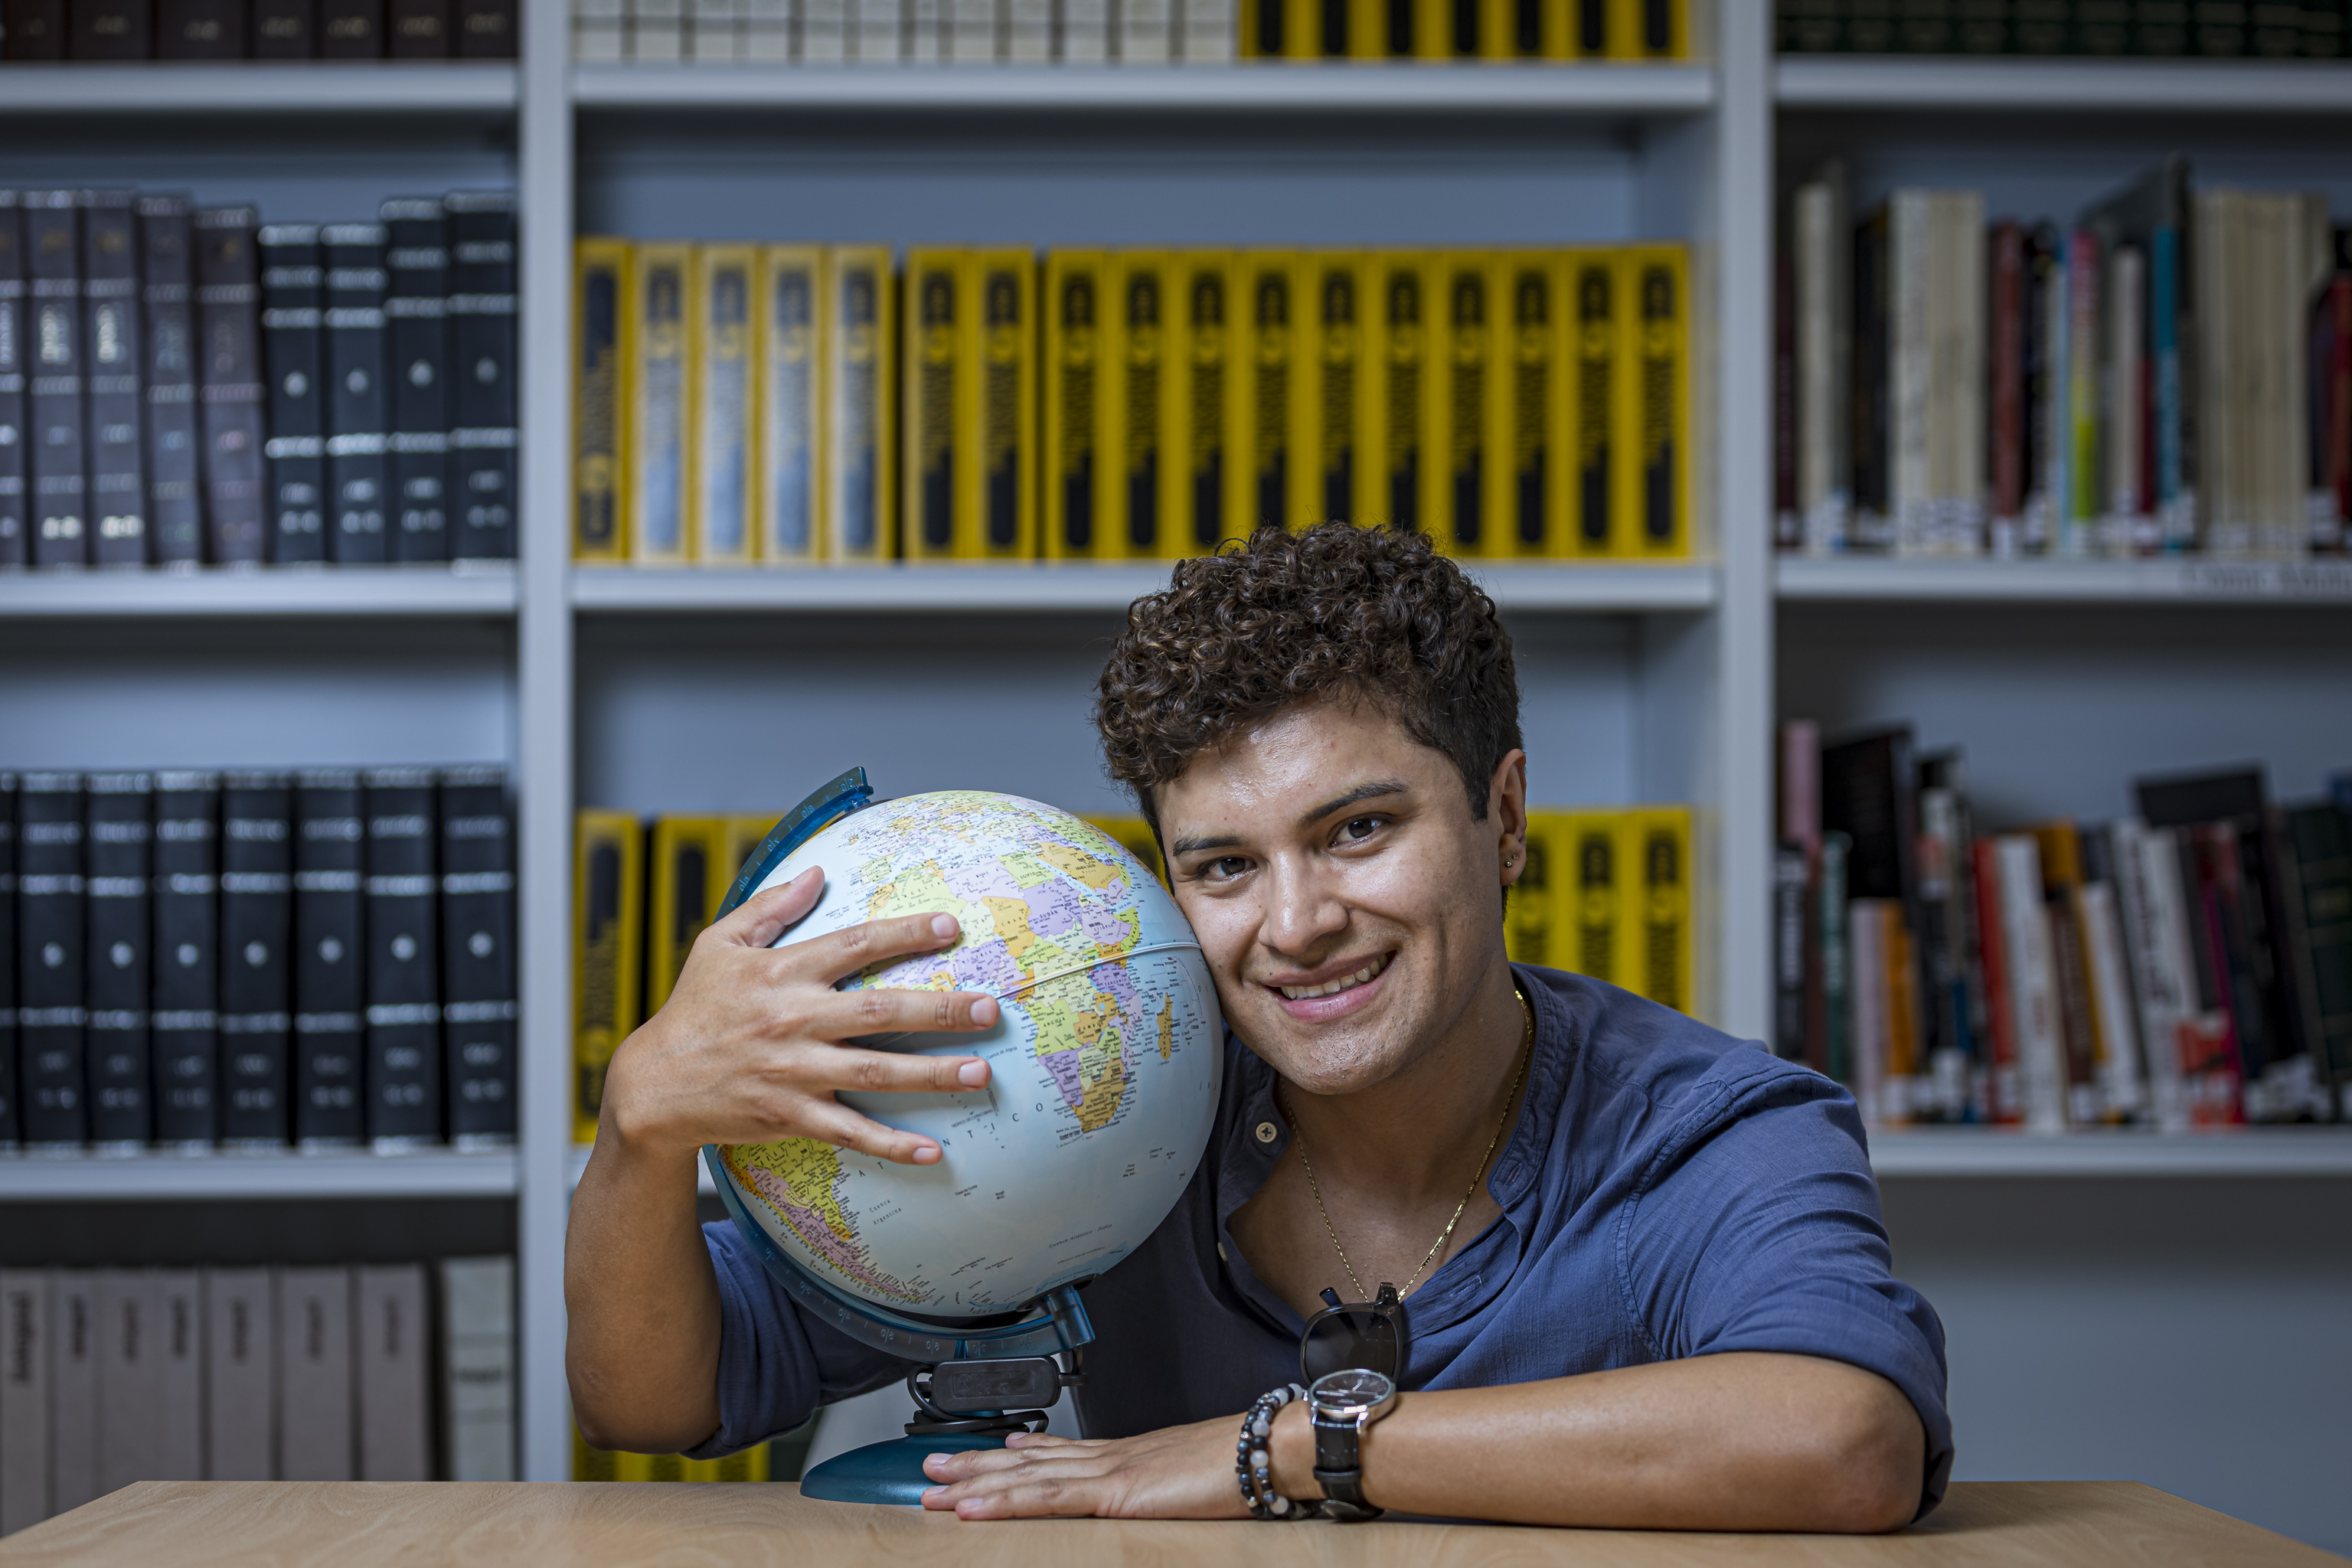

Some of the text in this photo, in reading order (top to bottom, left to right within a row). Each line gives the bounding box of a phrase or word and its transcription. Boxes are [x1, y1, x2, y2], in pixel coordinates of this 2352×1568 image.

[1040, 910, 1058, 919] SUDÁN
[1044, 1017, 1066, 1027] ANGOLA
[985, 1051, 999, 1060] Cuenca
[869, 1199, 890, 1213] Cuenca
[873, 1207, 902, 1225] Argentina
[1049, 1238, 1068, 1249] Cuenca
